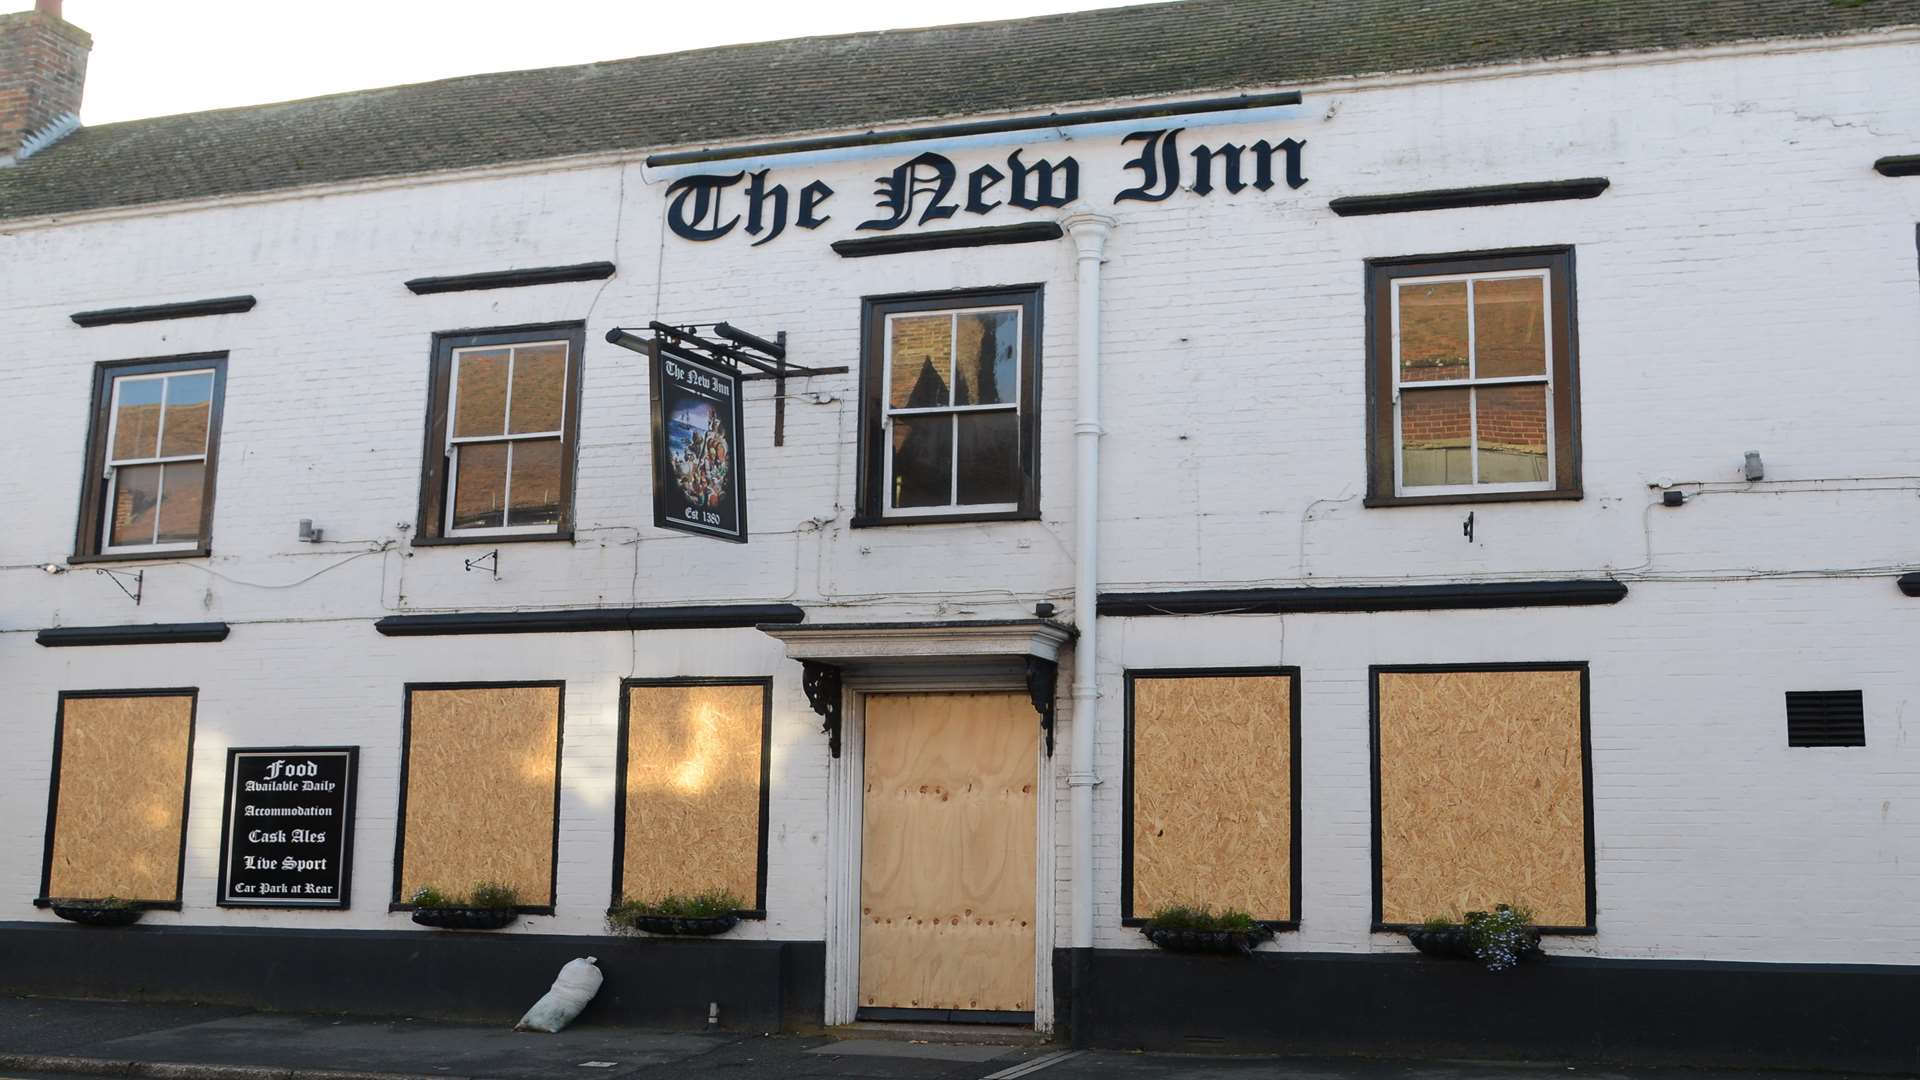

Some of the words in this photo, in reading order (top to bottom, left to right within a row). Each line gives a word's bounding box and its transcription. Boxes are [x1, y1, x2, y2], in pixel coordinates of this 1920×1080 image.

[665, 168, 835, 247] The
[855, 147, 1080, 231] New
[1113, 127, 1309, 204] Inn
[665, 360, 685, 380] The
[687, 370, 710, 388] New
[712, 377, 730, 396] Inn
[685, 506, 699, 520] Est
[263, 760, 318, 780] Food
[244, 780, 298, 792] Available
[302, 780, 336, 793] Daily
[244, 805, 332, 816] Accommodation
[248, 829, 286, 843] Cask
[291, 828, 326, 843] Ales
[243, 855, 277, 870] Live
[281, 856, 327, 872] Sport
[234, 882, 256, 893] Car
[259, 882, 288, 895] Park
[290, 884, 301, 893] at
[304, 882, 333, 894] Rear
